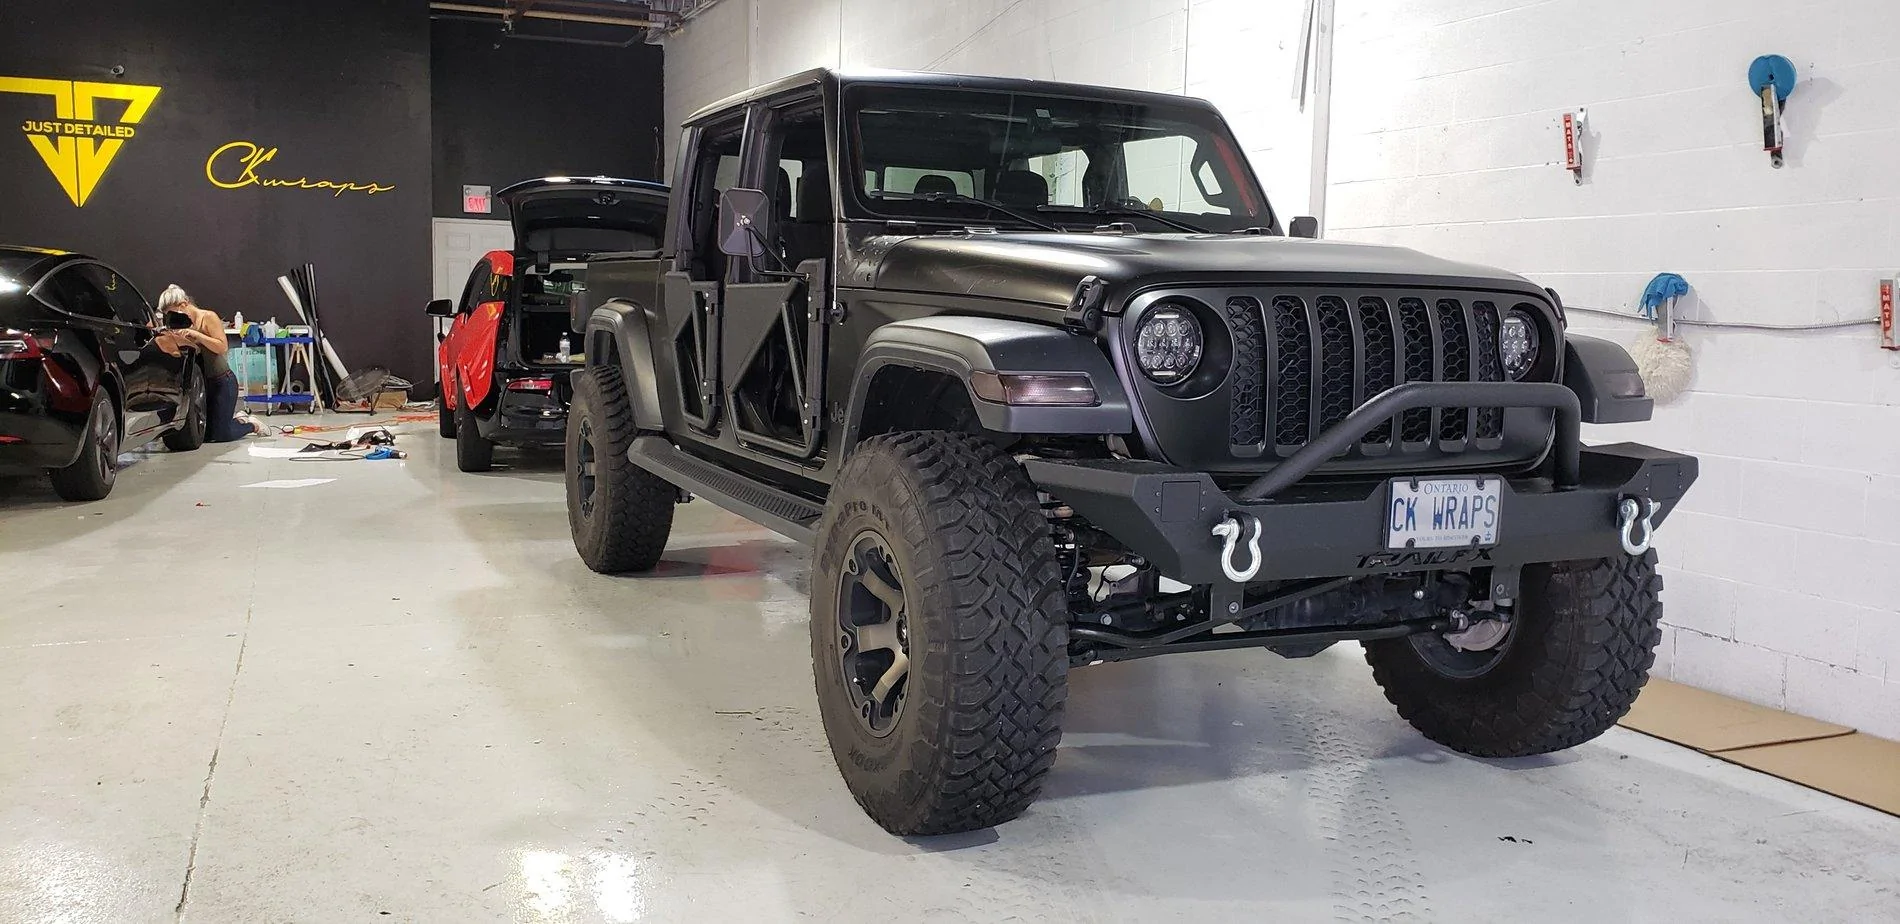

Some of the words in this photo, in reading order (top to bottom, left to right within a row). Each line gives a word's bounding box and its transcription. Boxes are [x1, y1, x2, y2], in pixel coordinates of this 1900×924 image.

[22, 120, 62, 133] JUST
[64, 122, 135, 138] DETAILED
[1424, 483, 1469, 495] ONTARIO
[1392, 497, 1418, 532] CK
[1432, 495, 1497, 531] WRAPS
